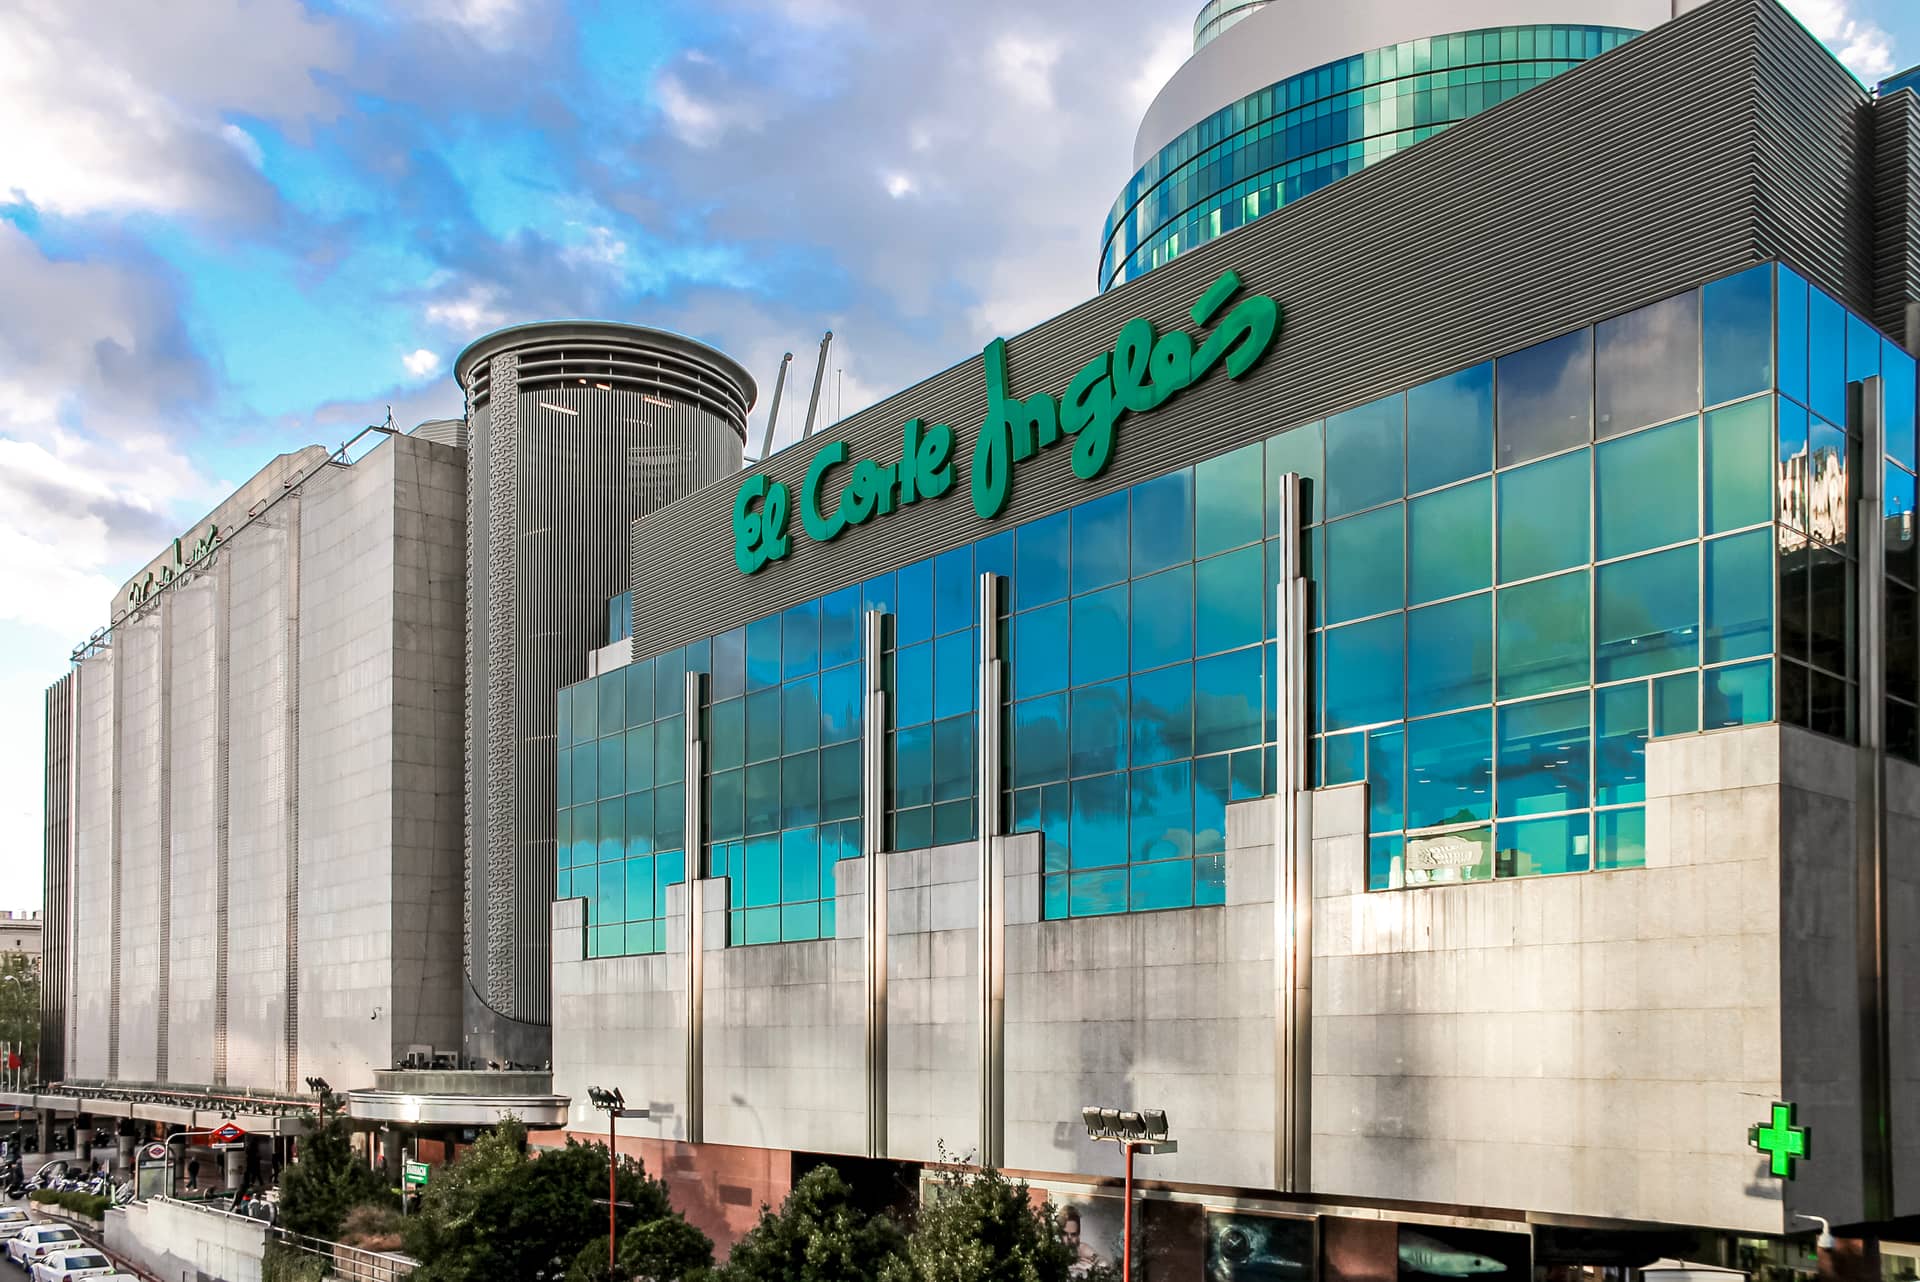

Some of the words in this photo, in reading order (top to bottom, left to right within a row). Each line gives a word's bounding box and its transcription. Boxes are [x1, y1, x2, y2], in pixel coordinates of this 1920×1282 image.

[733, 473, 793, 575] El
[800, 419, 957, 542] Corte
[971, 268, 1283, 520] Inglés
